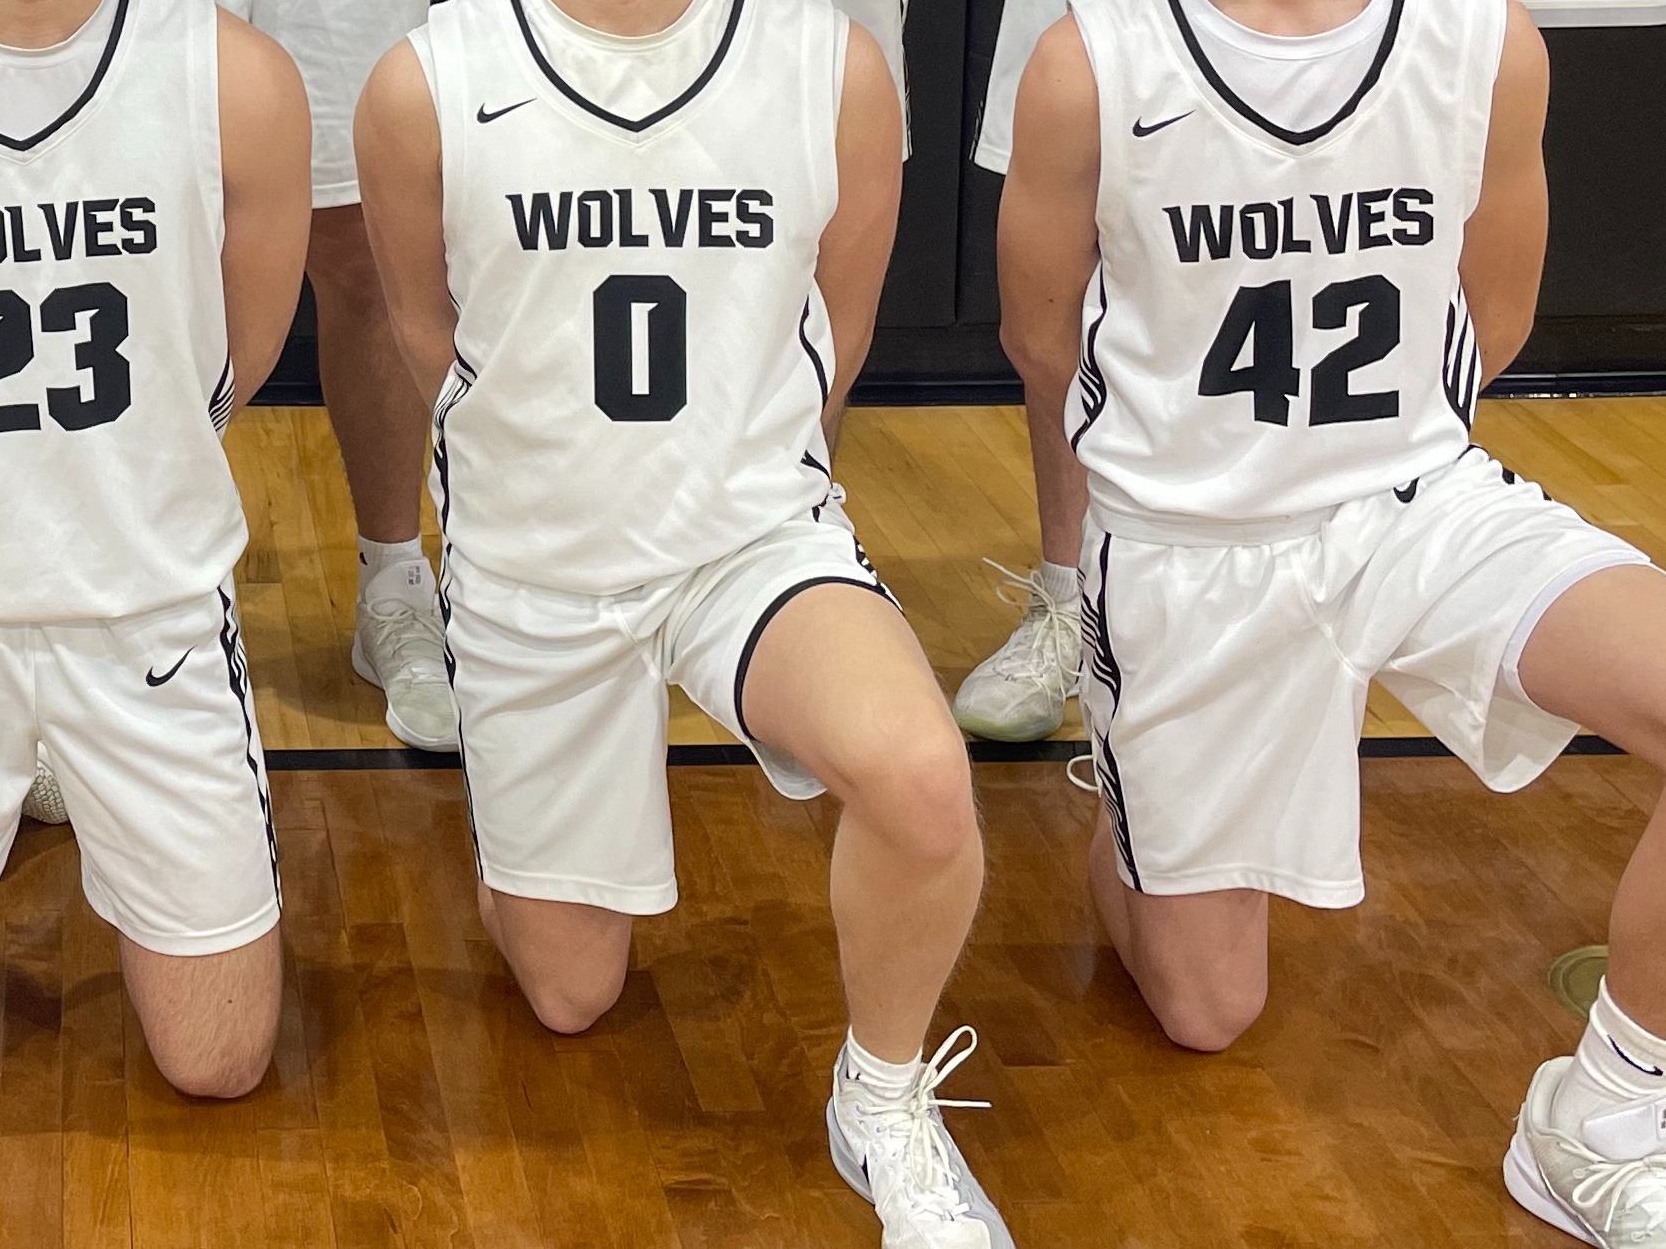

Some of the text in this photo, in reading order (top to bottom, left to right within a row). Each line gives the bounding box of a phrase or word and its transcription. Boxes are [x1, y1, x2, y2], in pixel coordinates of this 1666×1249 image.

[506, 189, 773, 250] WOLVES
[1162, 188, 1433, 263] WOLVES
[593, 275, 687, 421] 0
[1198, 275, 1400, 426] 42
